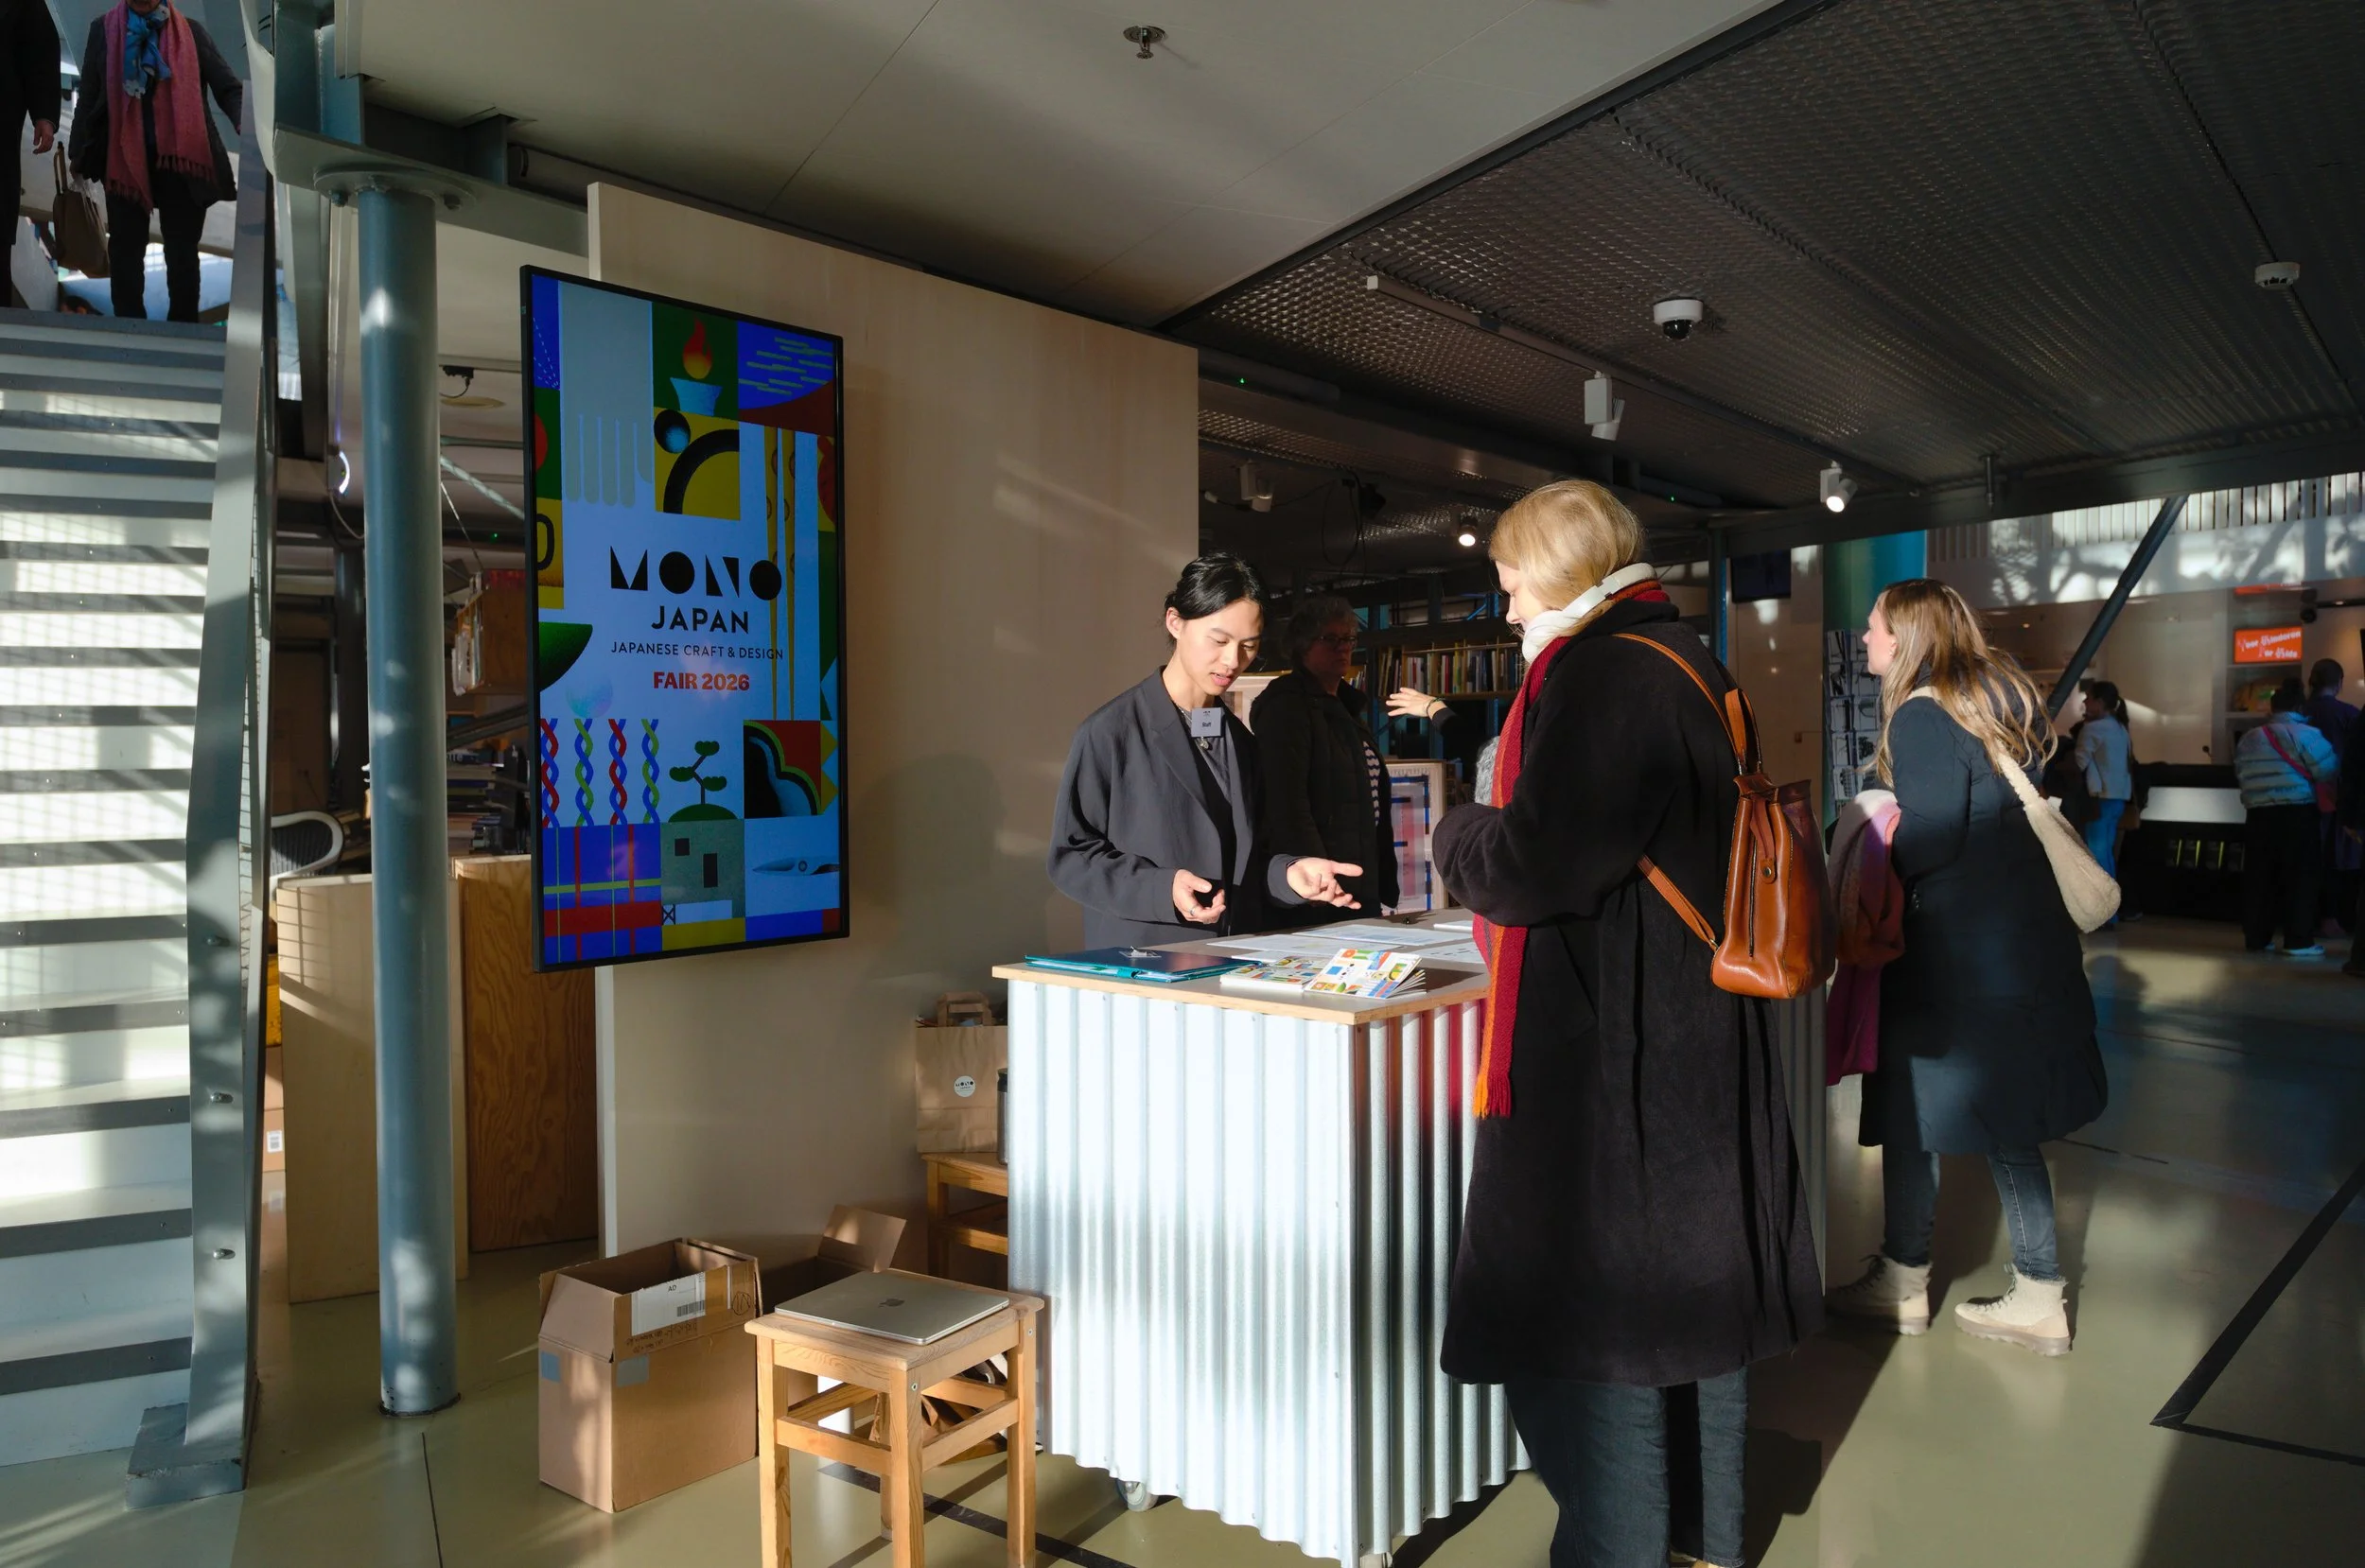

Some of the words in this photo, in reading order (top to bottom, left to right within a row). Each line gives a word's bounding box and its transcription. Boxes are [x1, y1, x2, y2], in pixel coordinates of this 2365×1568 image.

[610, 546, 782, 601] MONO
[651, 605, 749, 635] JAPAN
[611, 641, 679, 655] JAPANESE
[683, 644, 725, 657] CRAFT
[727, 646, 736, 658] &
[739, 647, 783, 660] DESIGN
[653, 671, 698, 689] FAIR
[701, 672, 750, 691] 2026
